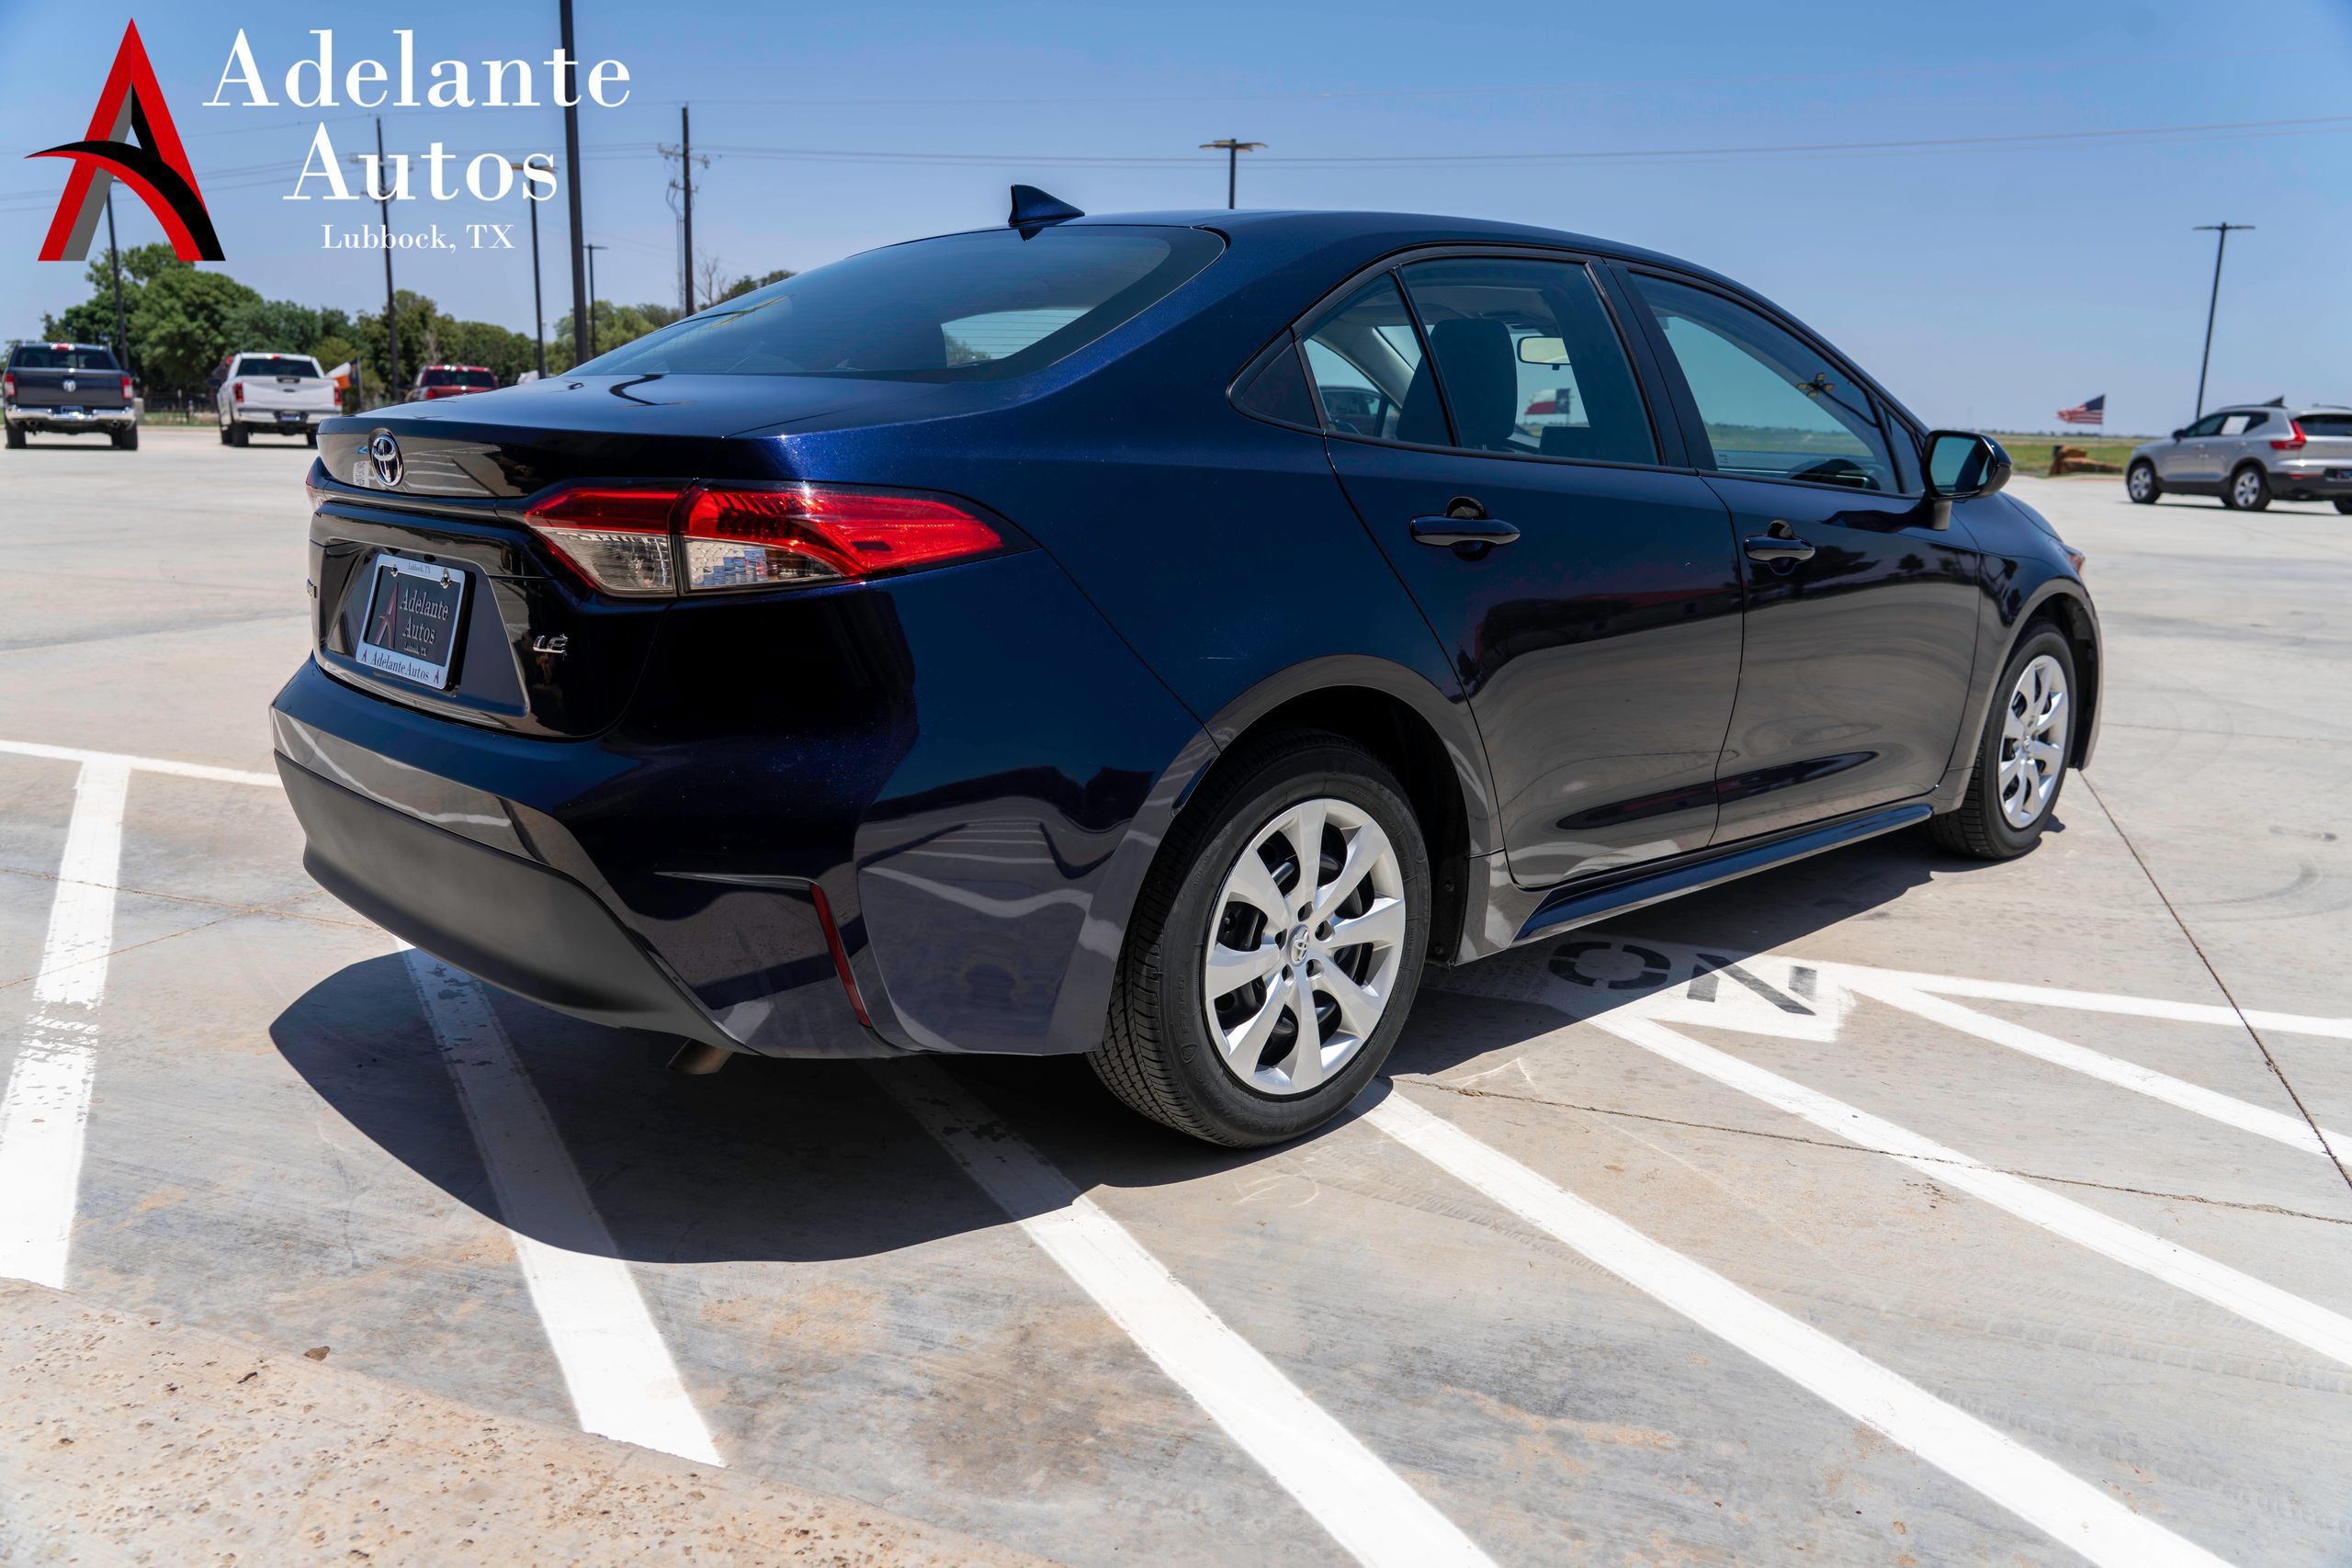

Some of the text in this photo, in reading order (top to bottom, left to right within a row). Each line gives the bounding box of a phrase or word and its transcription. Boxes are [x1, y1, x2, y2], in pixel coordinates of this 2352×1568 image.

[399, 588, 449, 621] Adelante
[402, 616, 436, 645] Autos
[371, 650, 405, 673] Adelante
[405, 661, 430, 681] Autos
[1548, 941, 1817, 1016] NO
